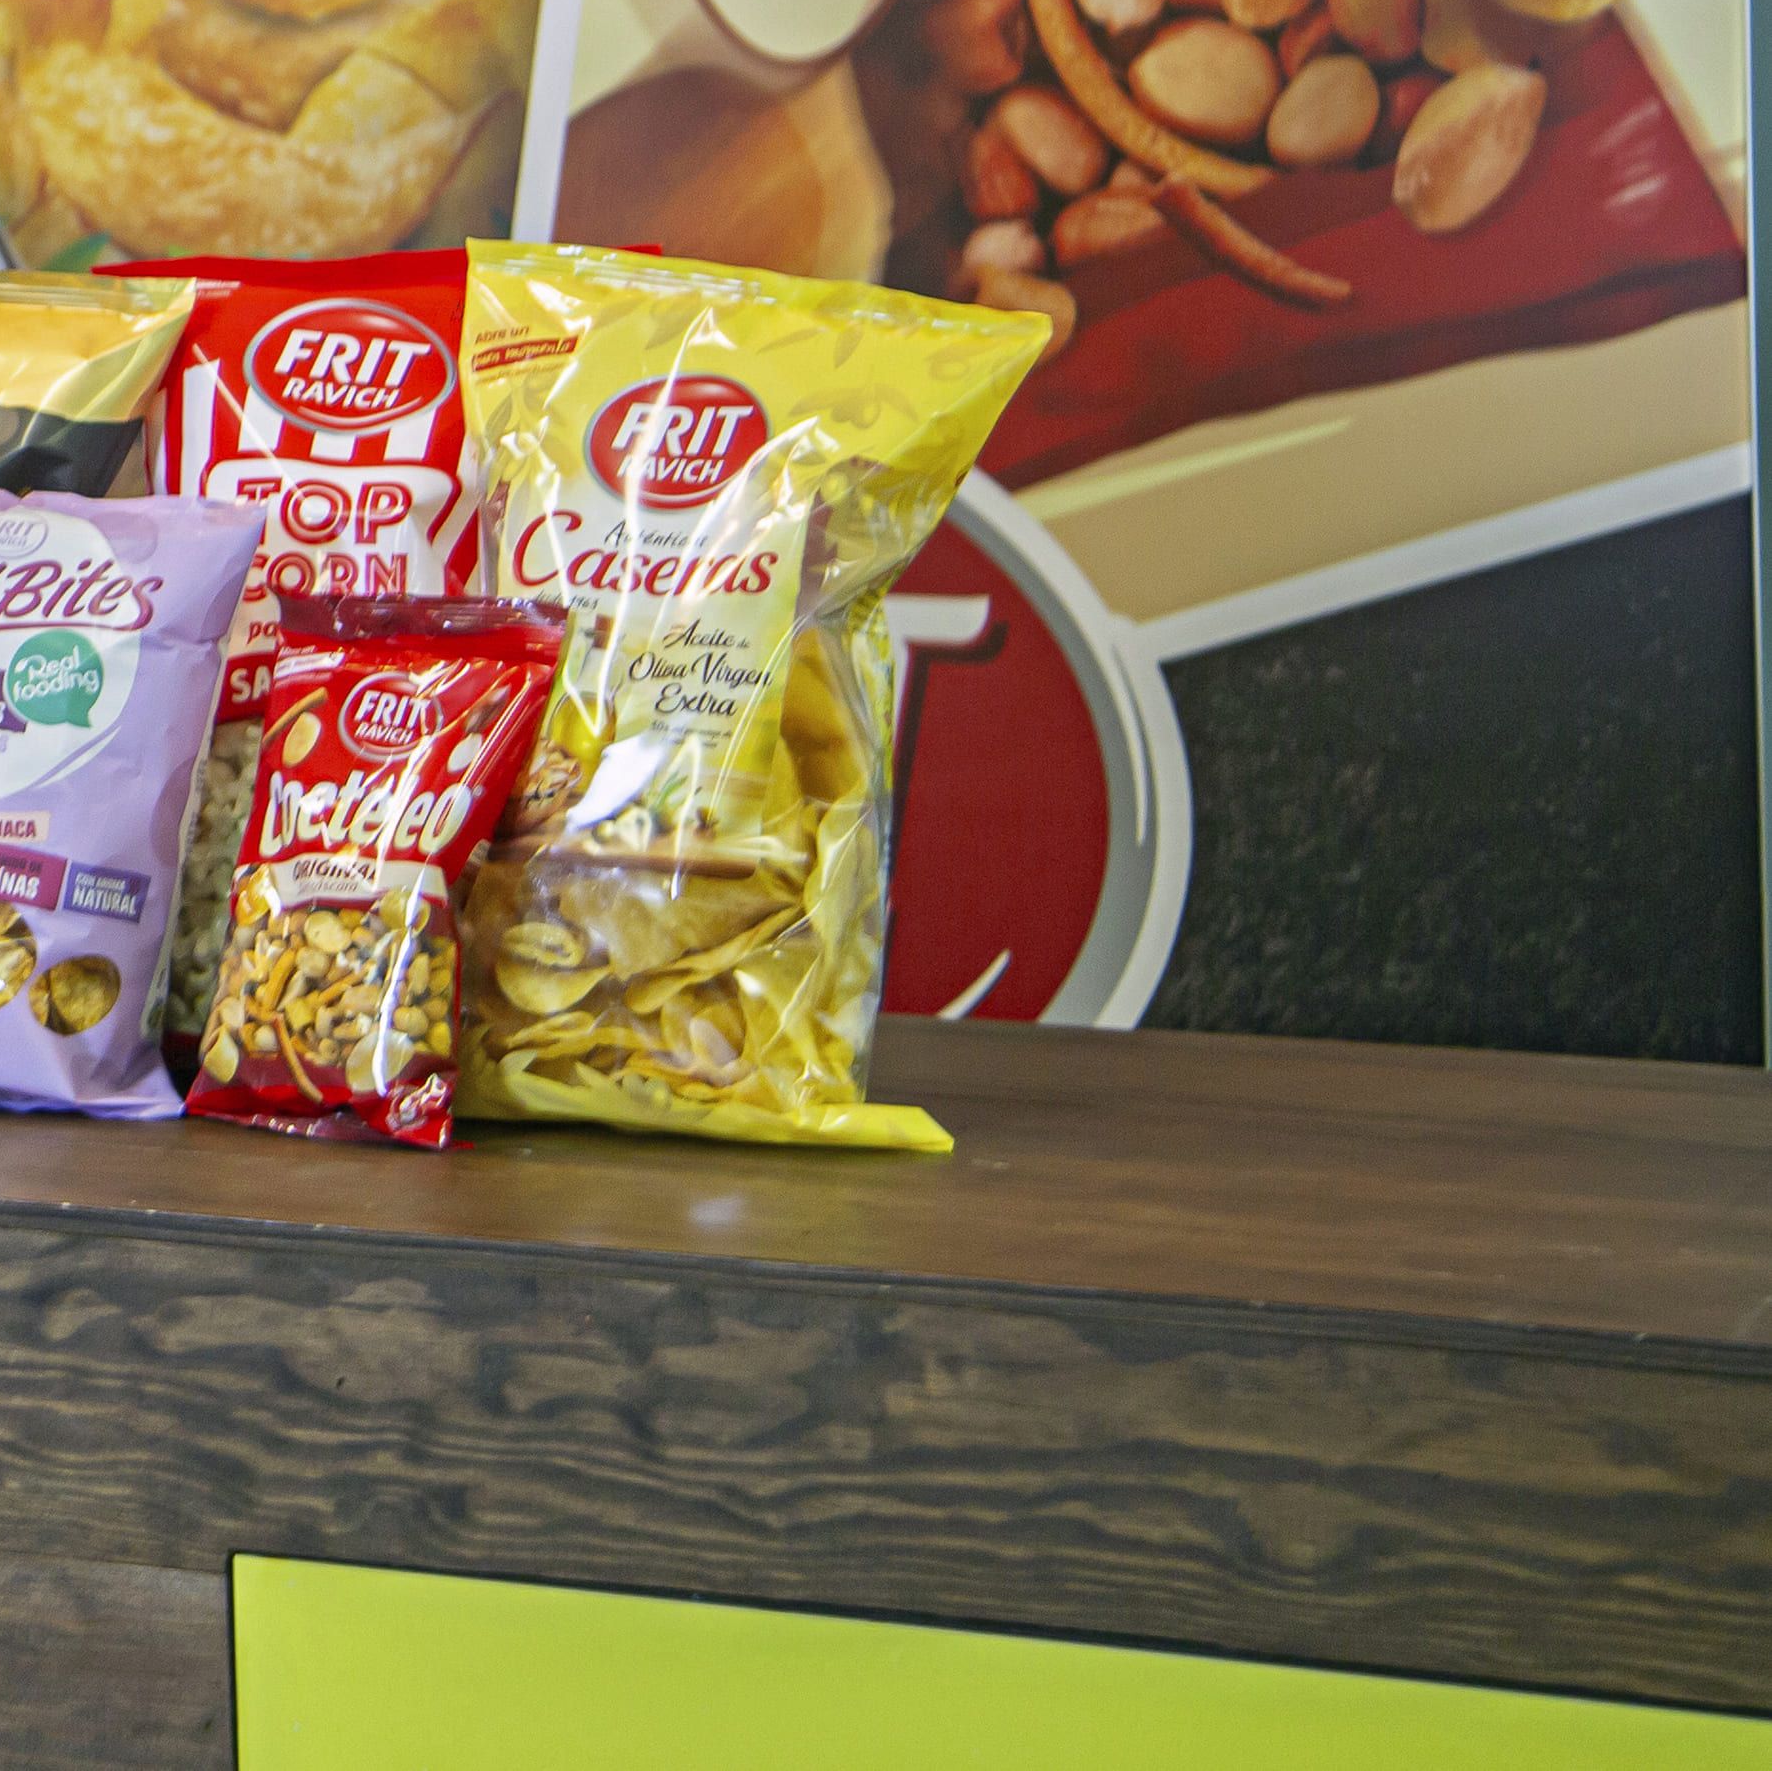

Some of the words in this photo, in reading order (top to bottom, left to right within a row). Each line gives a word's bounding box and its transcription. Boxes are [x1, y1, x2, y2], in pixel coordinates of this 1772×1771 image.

[274, 328, 432, 388] FRIT
[282, 376, 400, 409] RAVICH
[611, 401, 754, 458] FRIT
[238, 477, 413, 545] TOP
[512, 509, 779, 597] Caseras
[662, 618, 735, 650] Aceite
[14, 646, 81, 681] Real
[629, 651, 688, 681] Oliva
[691, 651, 773, 690] Virgen
[12, 668, 101, 703] fooding
[654, 682, 738, 717] Extra
[354, 690, 432, 729] FRIT
[355, 723, 414, 744] RAVICH
[71, 887, 138, 916] NATURAL
